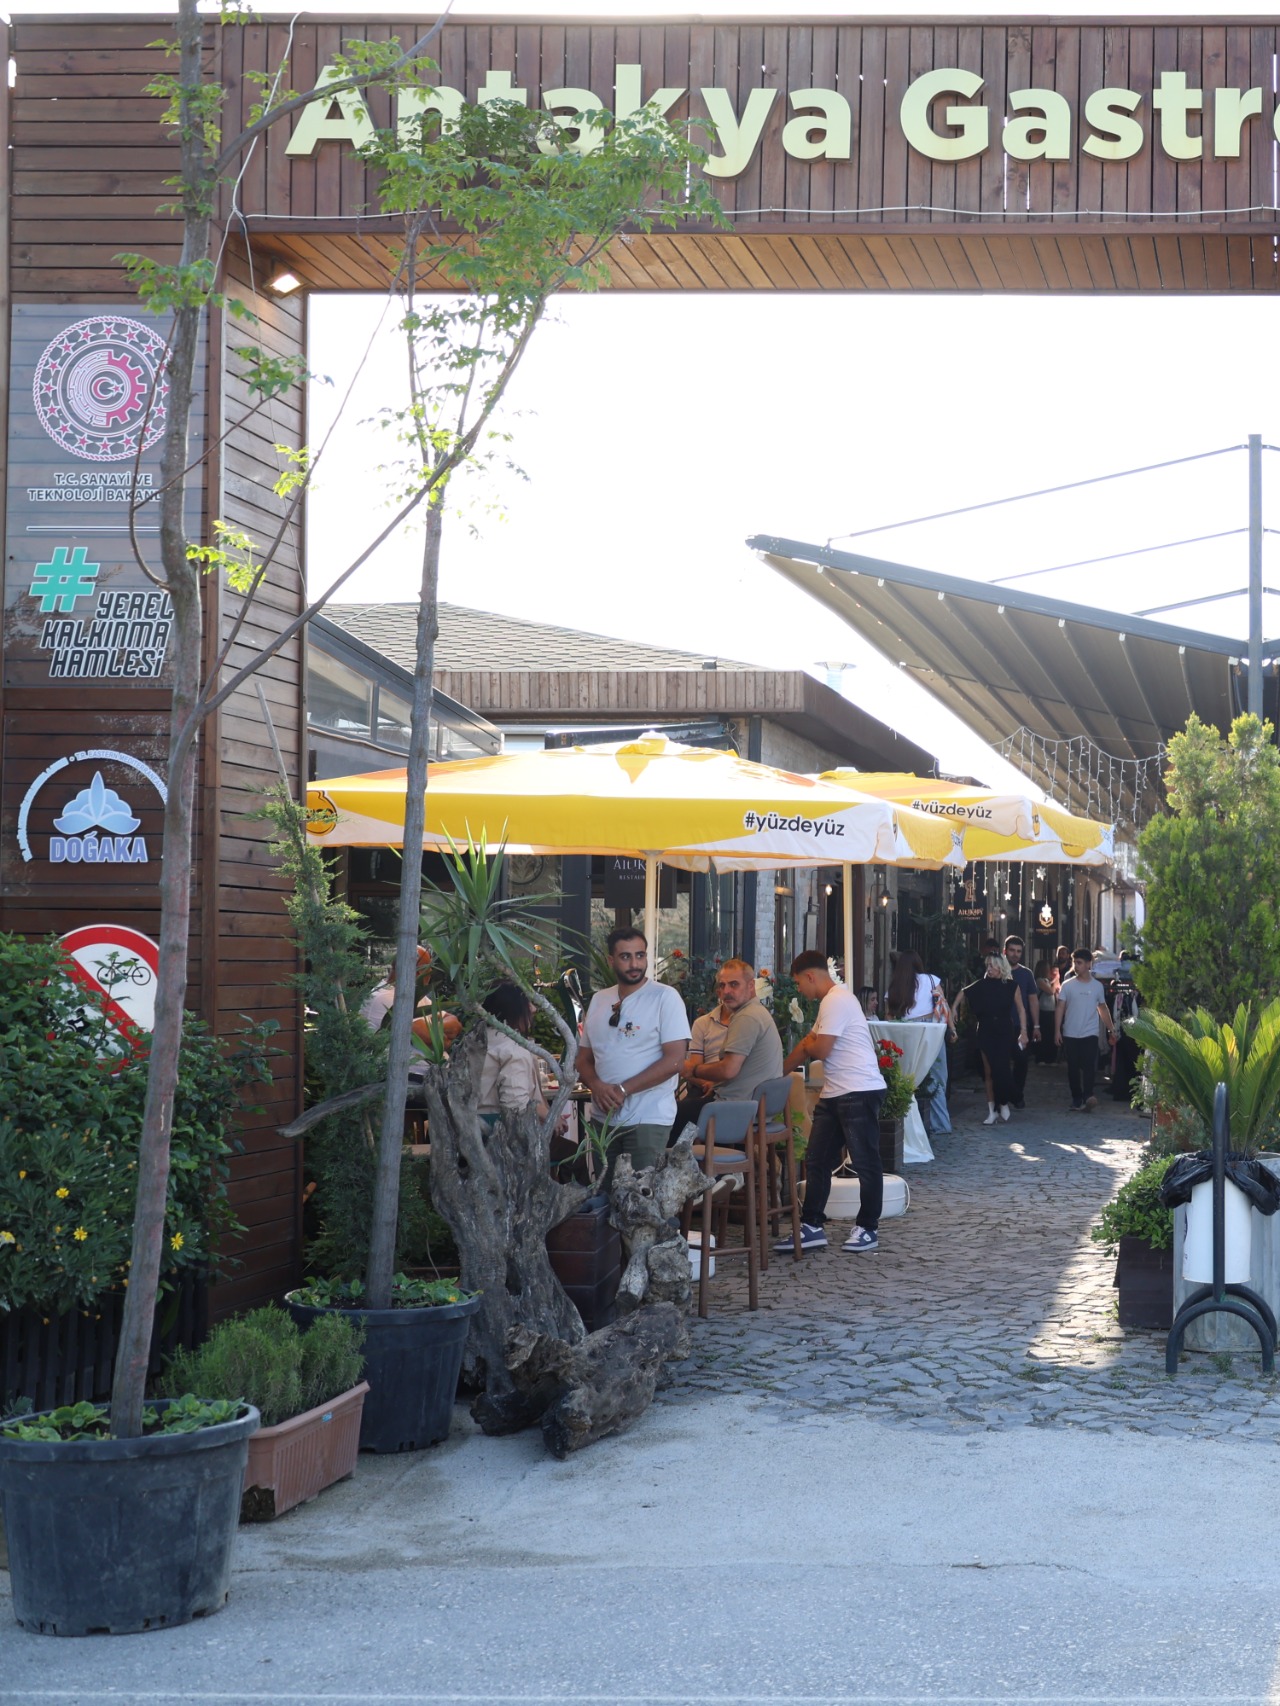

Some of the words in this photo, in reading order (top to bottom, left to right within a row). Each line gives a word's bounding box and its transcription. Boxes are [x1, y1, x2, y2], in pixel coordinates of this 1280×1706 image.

[55, 472, 78, 486] T.C.
[80, 470, 131, 486] SANAYİ
[134, 472, 153, 486] VE
[28, 486, 102, 501] TEKNOLOJİ
[96, 592, 174, 620] YEREL
[40, 620, 171, 648] KALKINMA
[912, 800, 993, 819] #yüzdeyüz
[745, 811, 845, 837] #yüzdeyüz
[49, 831, 148, 863] DOĞAKA
